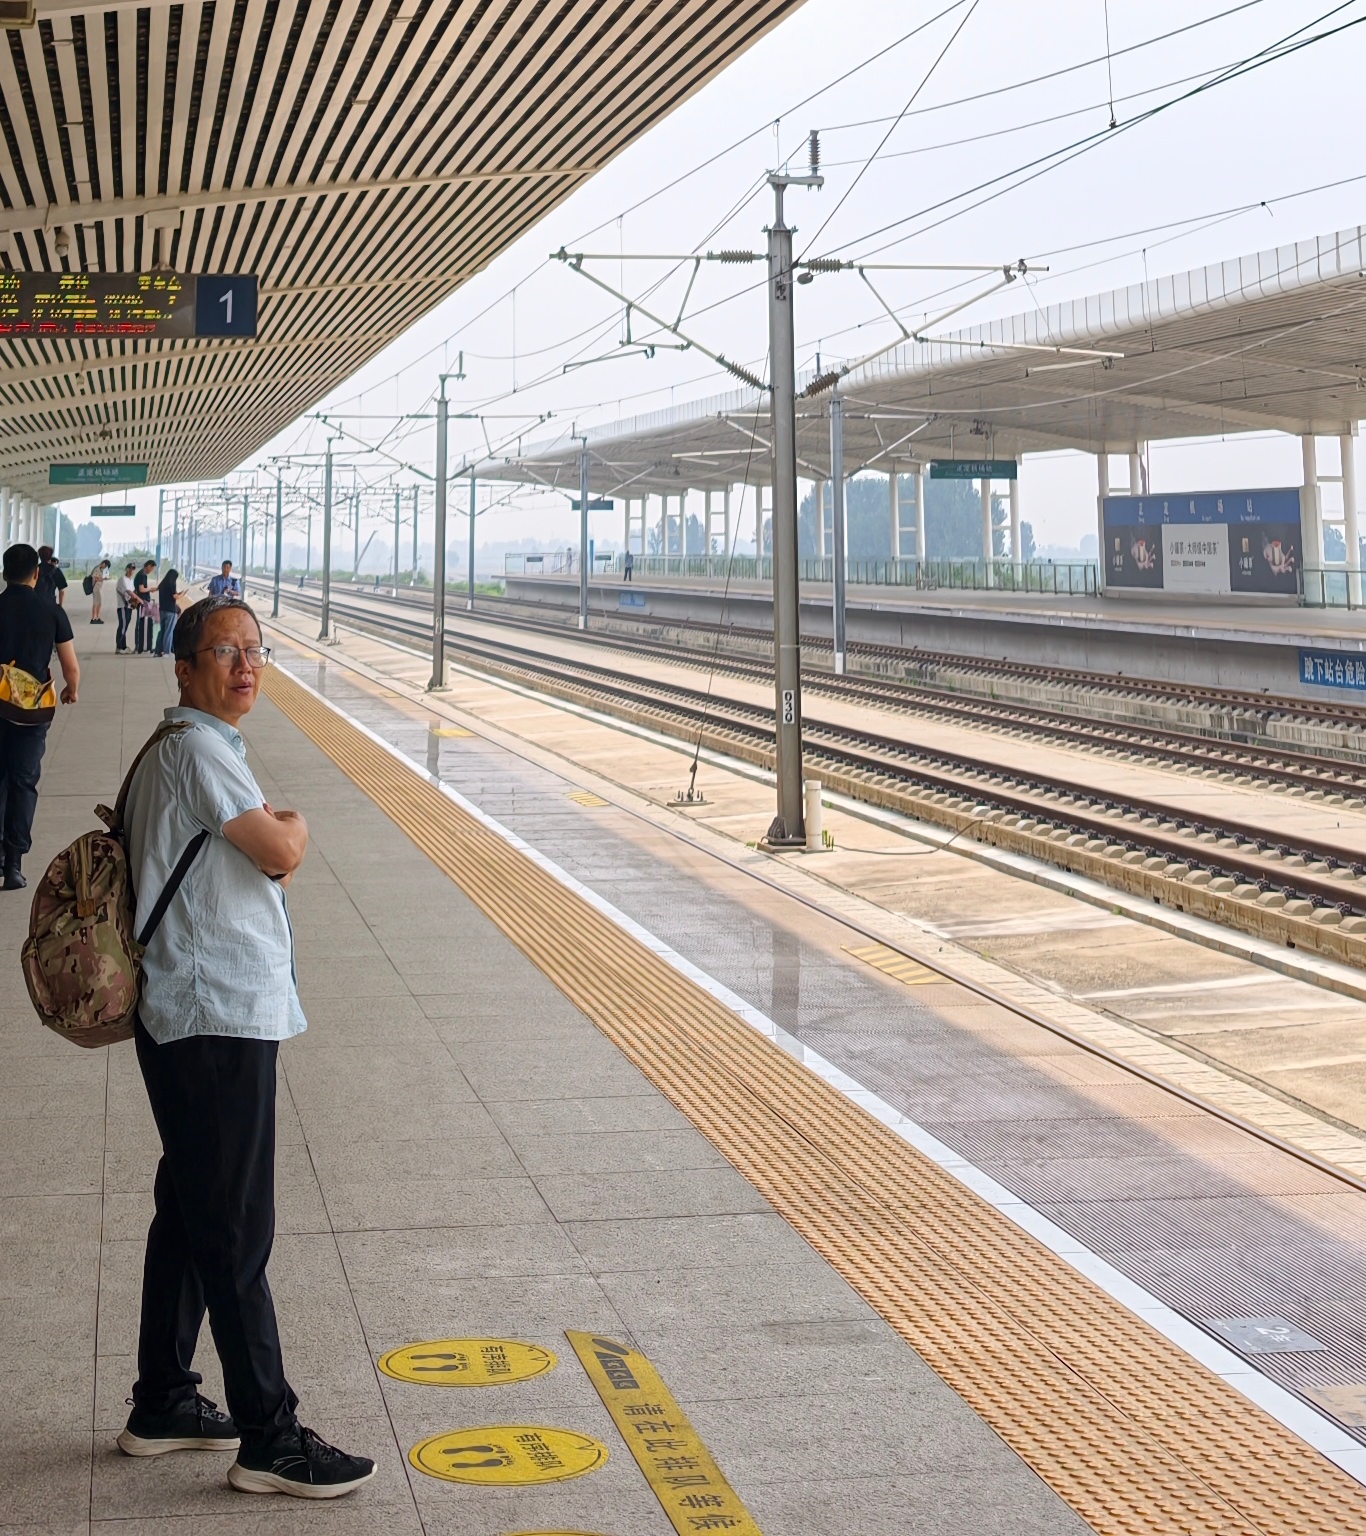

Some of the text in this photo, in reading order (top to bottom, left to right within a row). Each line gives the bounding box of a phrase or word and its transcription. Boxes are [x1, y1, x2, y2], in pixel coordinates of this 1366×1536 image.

[218, 289, 233, 324] 1
[1304, 656, 1366, 686] 跳下站台危险
[623, 1403, 742, 1530] 请在此排队等候
